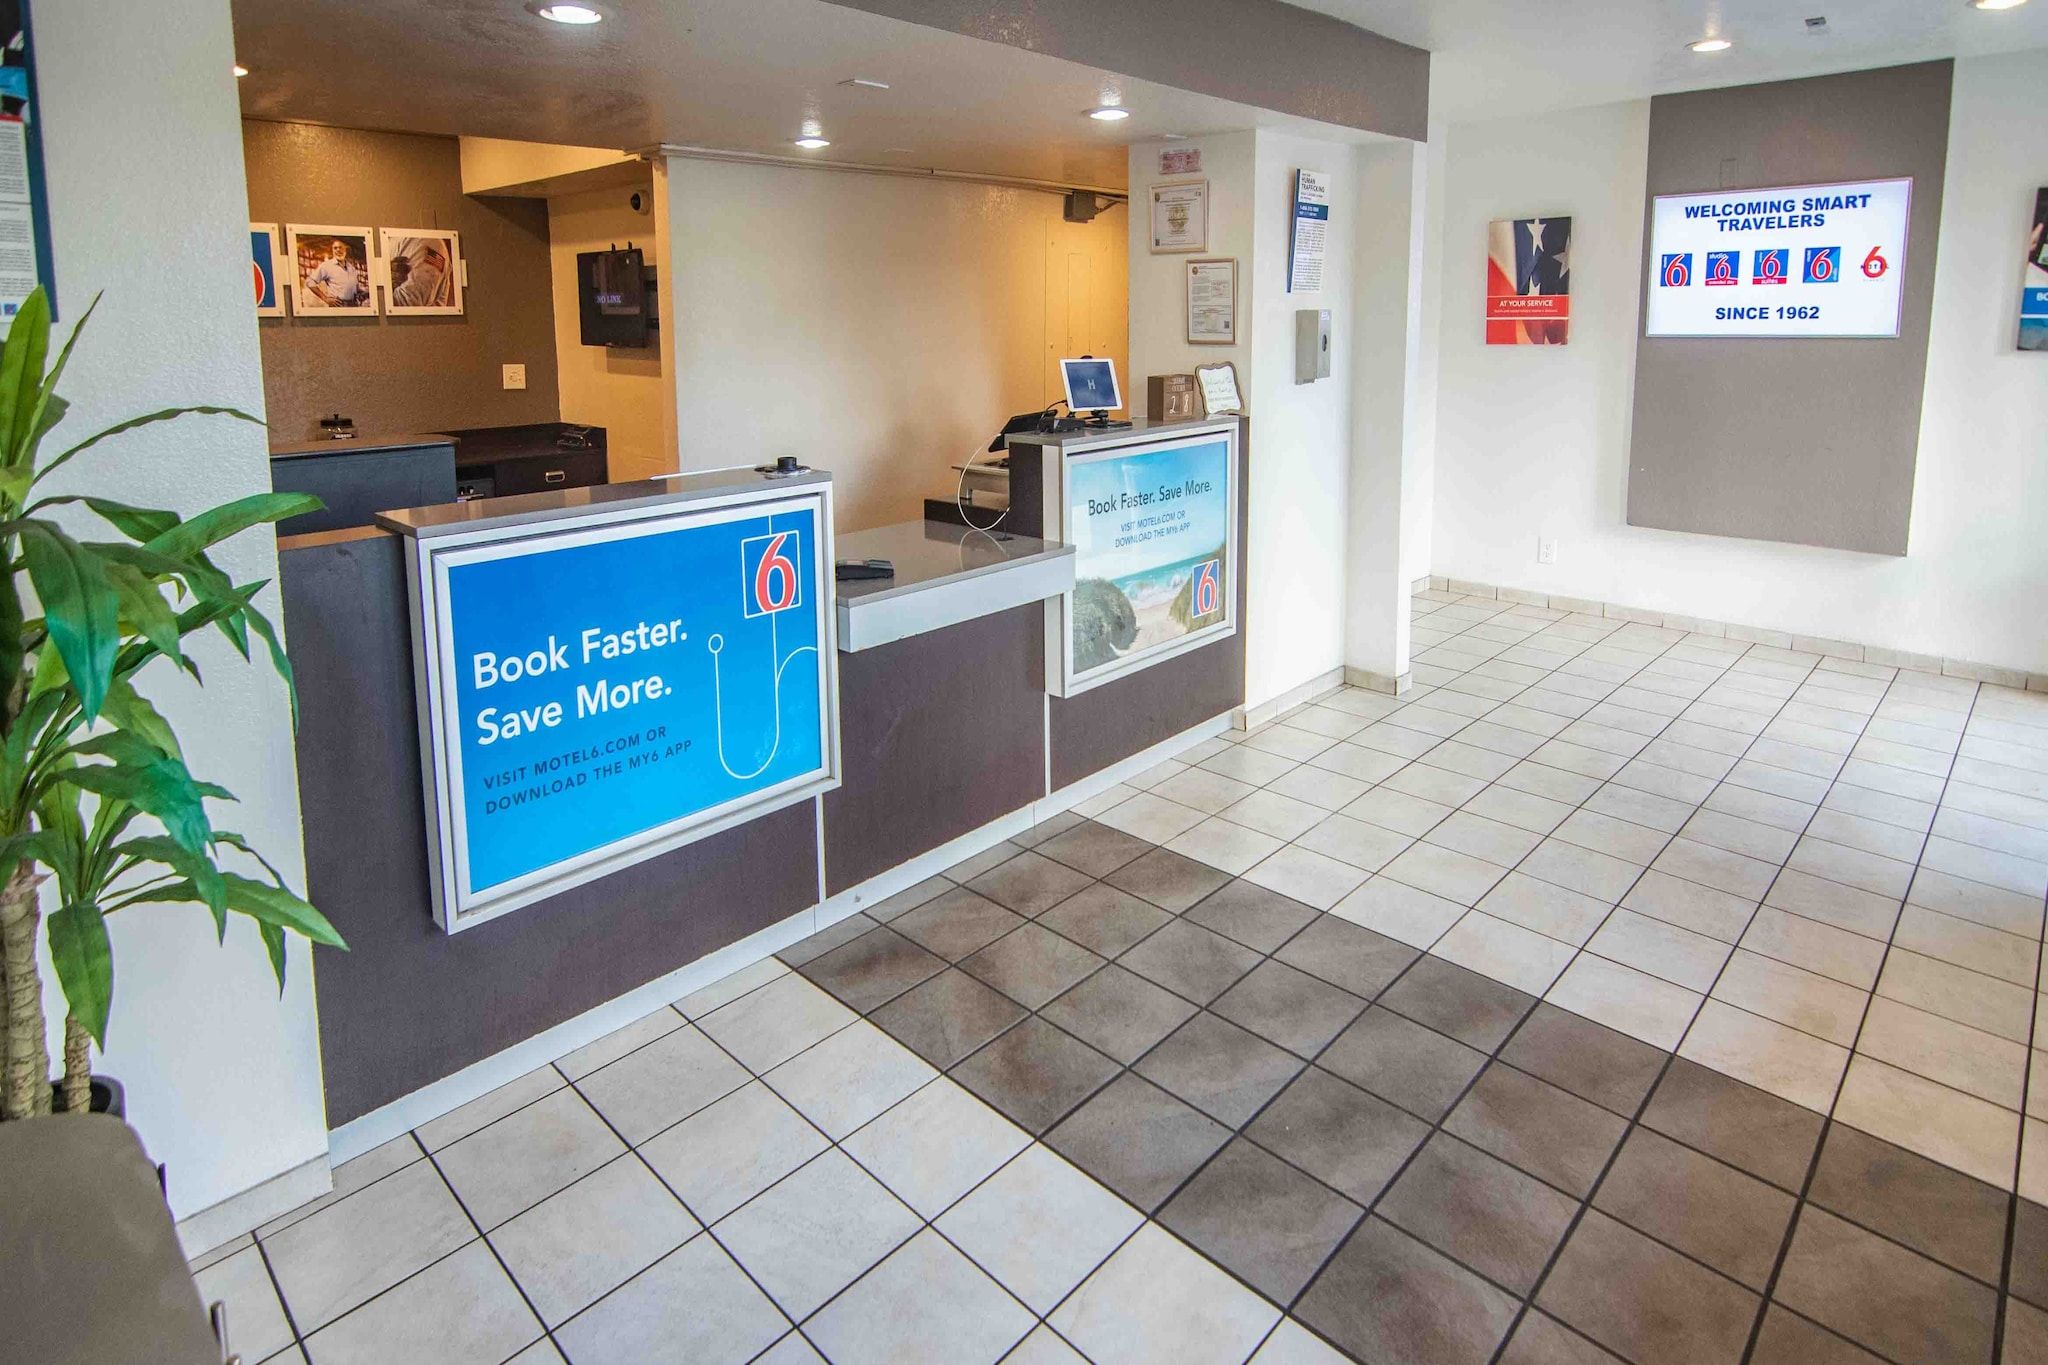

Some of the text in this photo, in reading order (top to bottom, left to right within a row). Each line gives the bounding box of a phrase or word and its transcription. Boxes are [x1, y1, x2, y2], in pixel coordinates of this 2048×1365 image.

[1685, 194, 1871, 219] WELCOMING SMART
[1717, 213, 1825, 232] TRAVELERS
[1665, 253, 1688, 287] 6
[1714, 255, 1731, 280] 6
[1761, 249, 1781, 279] 6
[1810, 248, 1833, 281] 6
[1863, 246, 1887, 278] 6
[1526, 299, 1553, 307] SERVICE
[1715, 306, 1820, 320] SINCE 1962
[1088, 480, 1212, 516] Book Faster. Save More.
[1115, 531, 1152, 548] DOWNLOAD
[1153, 528, 1165, 538] THE
[1179, 522, 1191, 533] APP
[1120, 521, 1135, 533] VISIT
[1177, 510, 1186, 521] OR
[755, 533, 797, 613] 6
[1197, 560, 1217, 614] 6
[473, 618, 687, 690] Book Faster.
[476, 674, 672, 746] Save More.
[483, 726, 667, 790] VISIT MOTEL6.COM OR
[485, 740, 692, 815] DOWNLOAD THE MY6 APP
